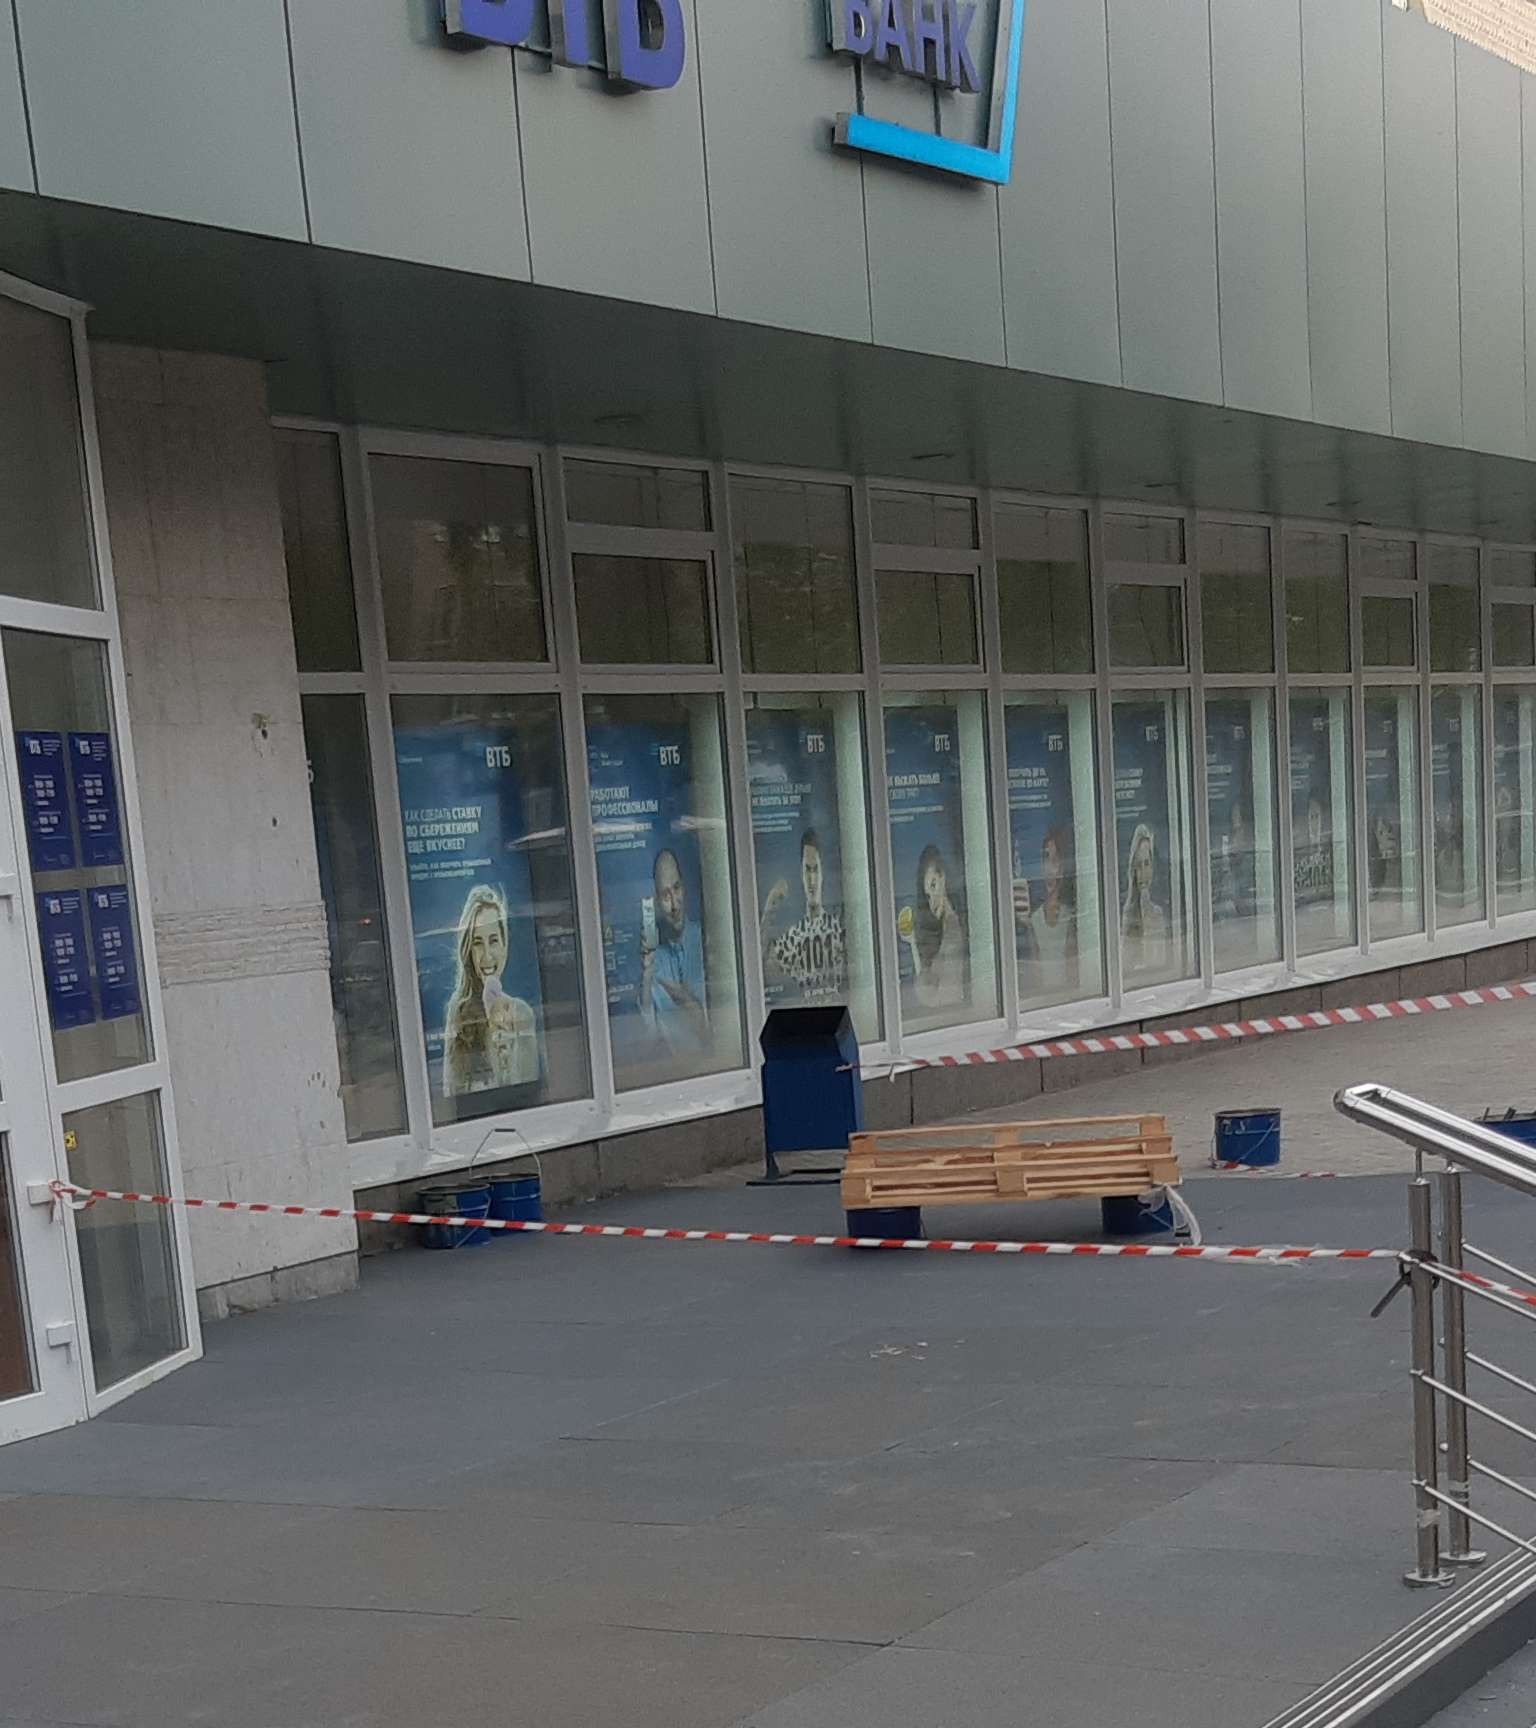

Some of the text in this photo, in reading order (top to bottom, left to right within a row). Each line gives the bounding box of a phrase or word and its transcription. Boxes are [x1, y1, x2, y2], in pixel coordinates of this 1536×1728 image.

[807, 734, 825, 753] ВТБ
[935, 734, 951, 752] ВТБ
[1048, 735, 1064, 751] ВТБ
[486, 745, 512, 768] ВТБ
[659, 745, 681, 766] ВТБ
